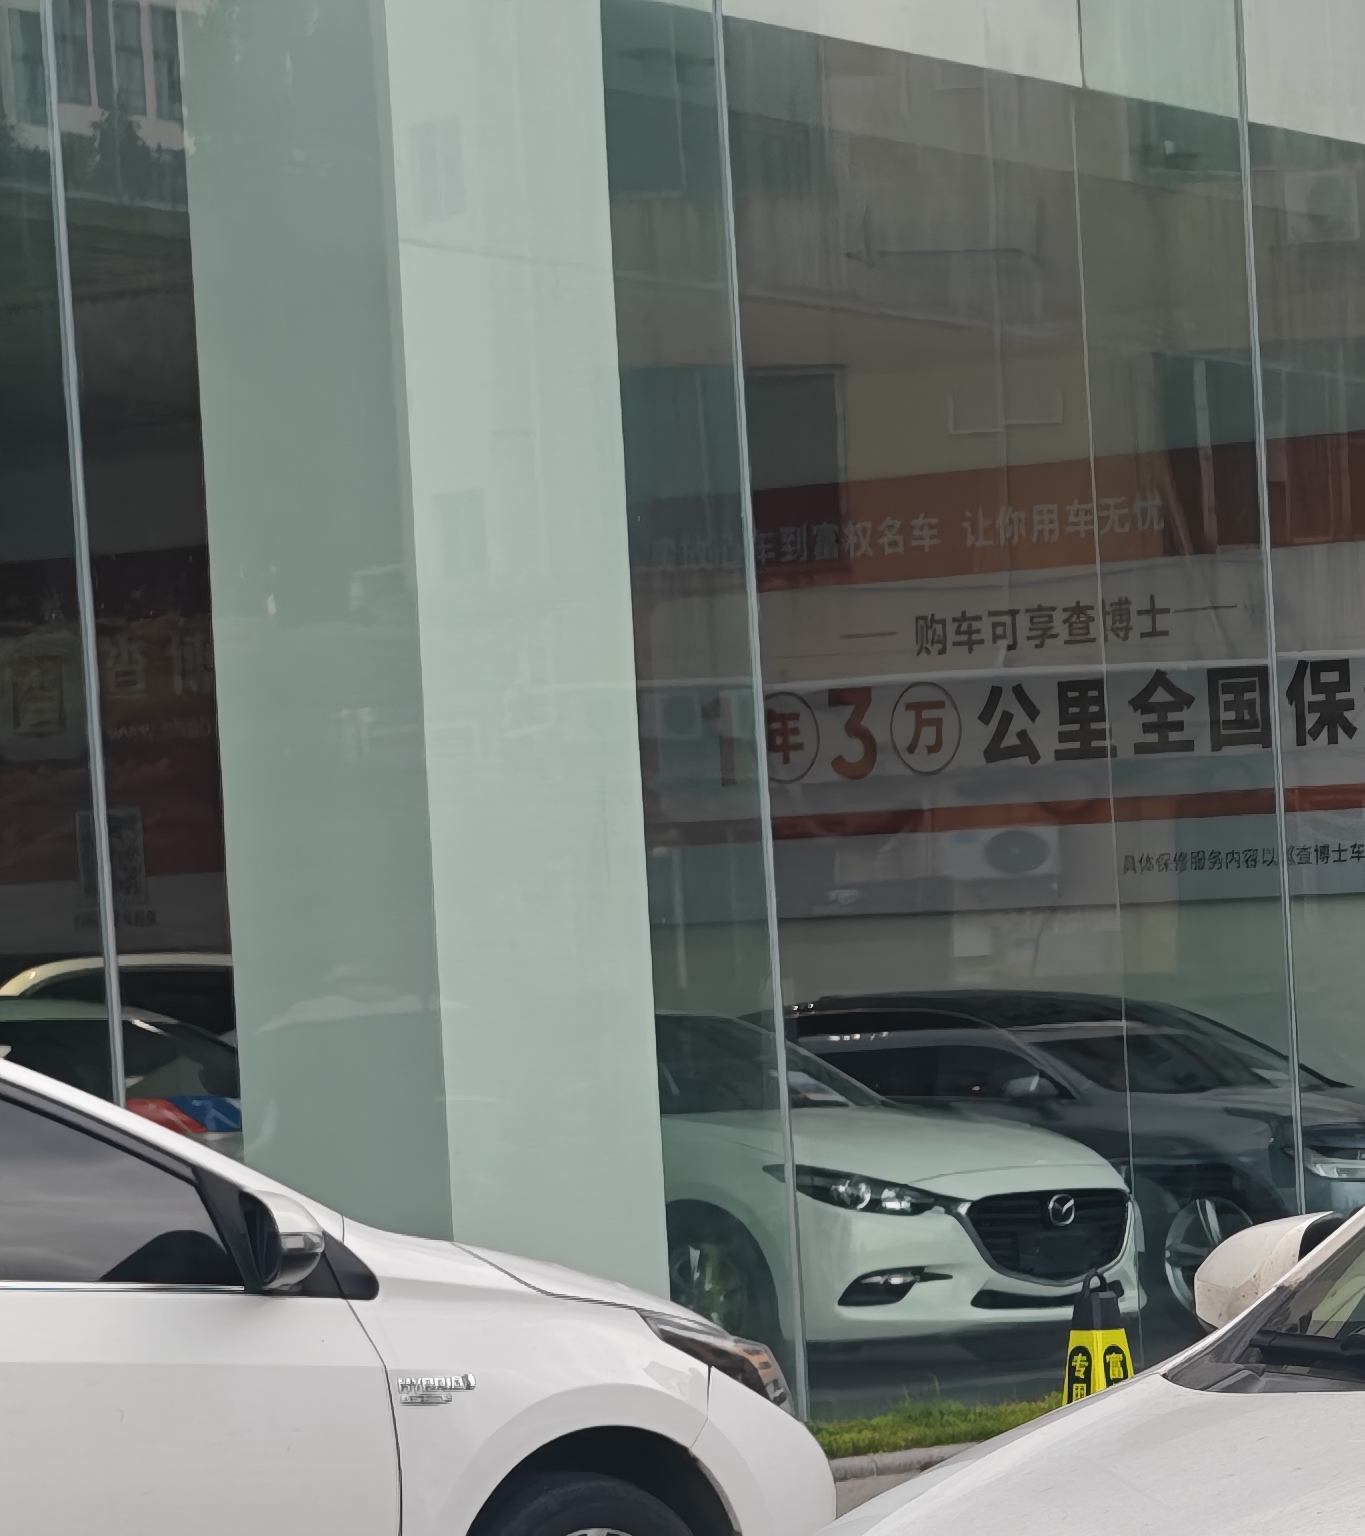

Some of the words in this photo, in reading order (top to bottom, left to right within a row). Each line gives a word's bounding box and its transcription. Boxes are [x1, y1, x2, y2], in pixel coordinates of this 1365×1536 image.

[913, 593, 1172, 659] 购车可享查博士
